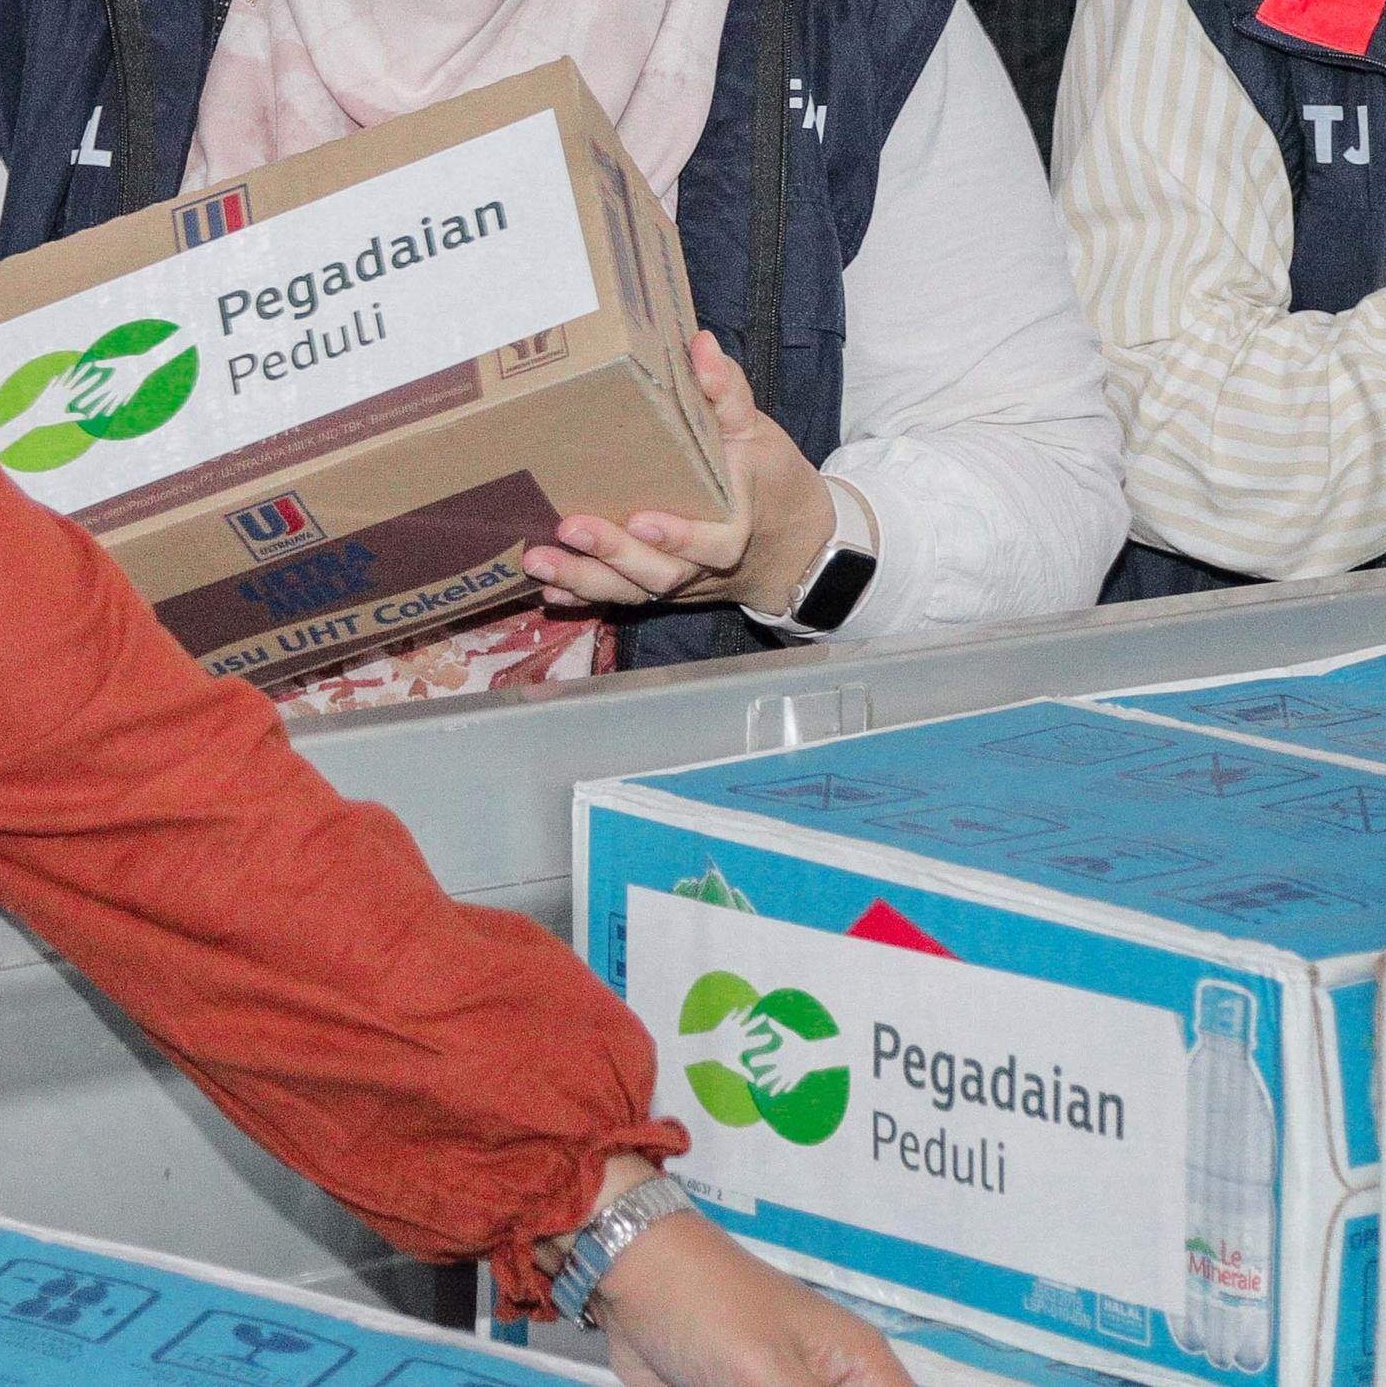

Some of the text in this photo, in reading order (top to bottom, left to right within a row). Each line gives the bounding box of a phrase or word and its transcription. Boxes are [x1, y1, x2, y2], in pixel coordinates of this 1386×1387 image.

[1302, 104, 1371, 165] TJ
[217, 200, 509, 336] Pegadaian
[228, 302, 387, 395] Peduli
[276, 613, 363, 653] UHT
[372, 562, 519, 625] Cokelat
[872, 1021, 1125, 1141] Pegadaian
[871, 1109, 1006, 1195] Peduli
[1188, 1252, 1262, 1292] Minerale
[1220, 1239, 1243, 1265] Le
